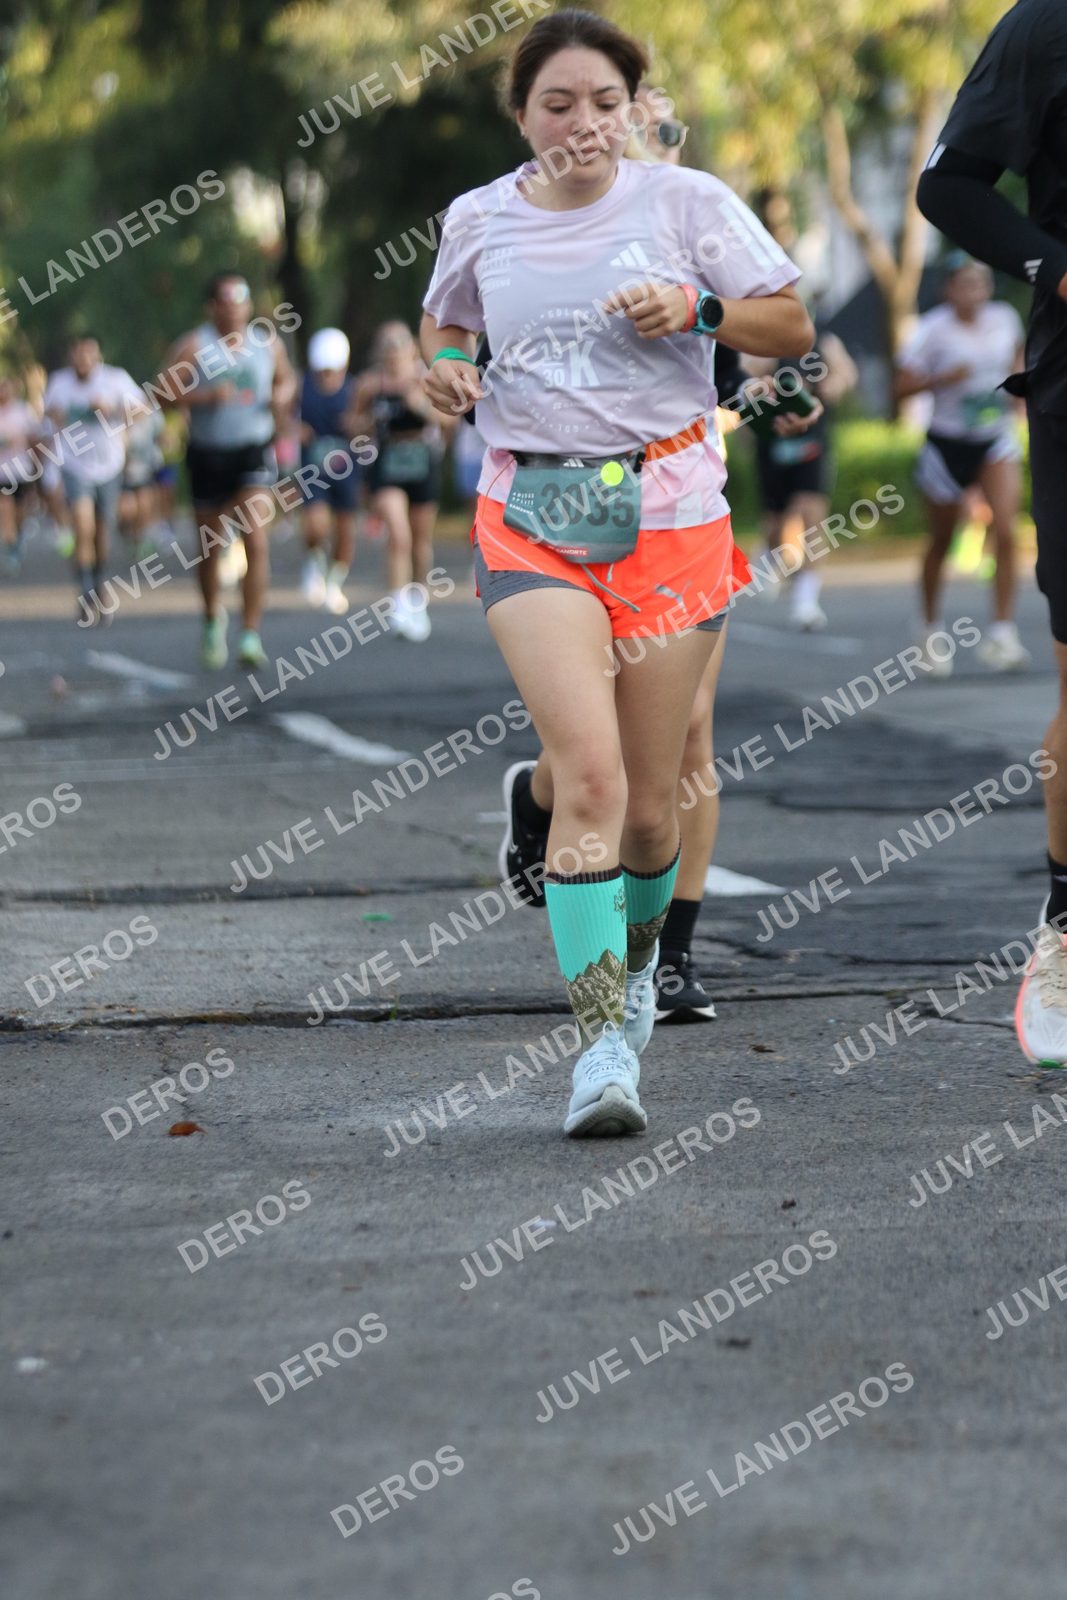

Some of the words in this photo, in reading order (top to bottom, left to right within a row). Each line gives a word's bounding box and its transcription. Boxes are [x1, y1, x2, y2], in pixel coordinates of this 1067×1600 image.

[543, 368, 566, 388] 30
[569, 340, 600, 387] K
[541, 482, 635, 528] 2035
